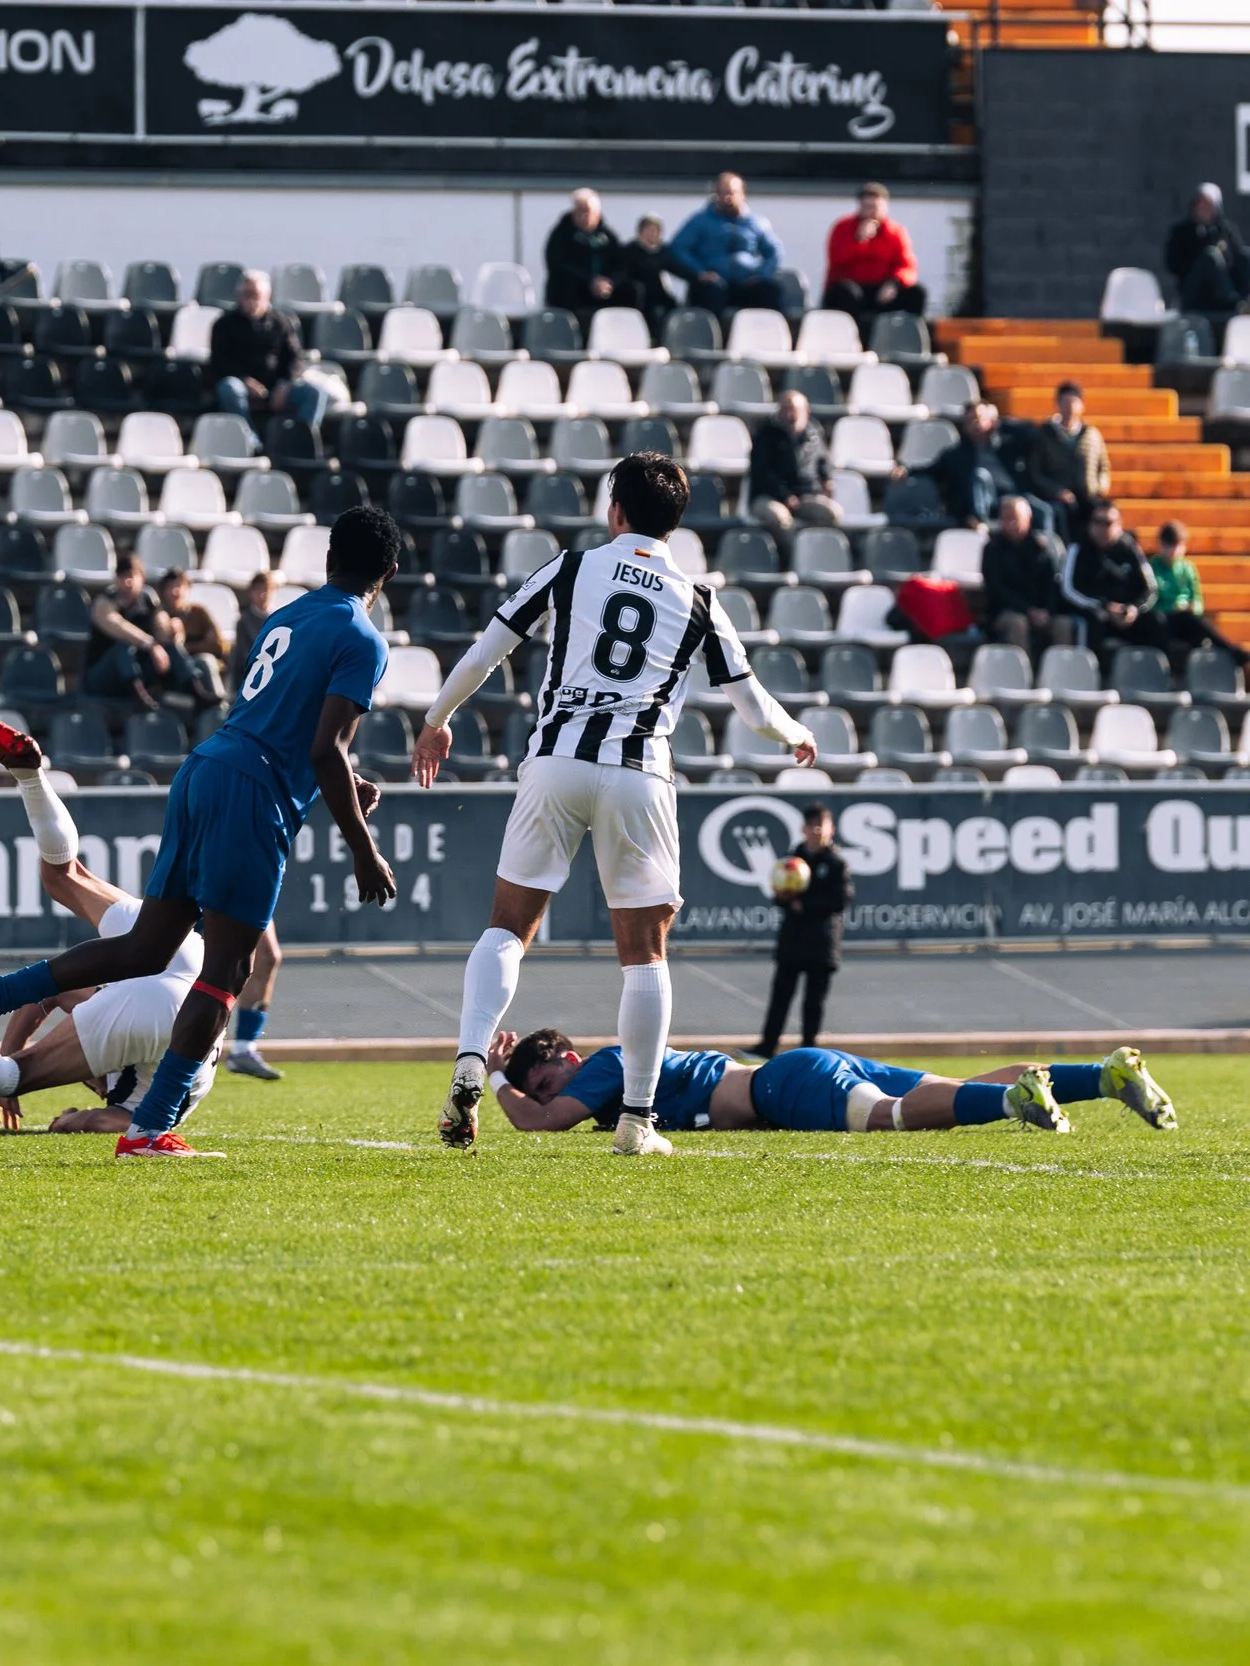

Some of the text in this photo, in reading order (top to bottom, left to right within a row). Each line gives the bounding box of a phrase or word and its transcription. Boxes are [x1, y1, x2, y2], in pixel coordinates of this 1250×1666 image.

[343, 35, 897, 139] Dehesa Extremeña Catering
[612, 562, 664, 592] JESUS
[241, 626, 293, 701] 8
[591, 590, 657, 683] 8
[839, 800, 1250, 890] Speed Qu
[1059, 896, 1118, 933] JOSÉ
[1121, 894, 1199, 926] MARÍA
